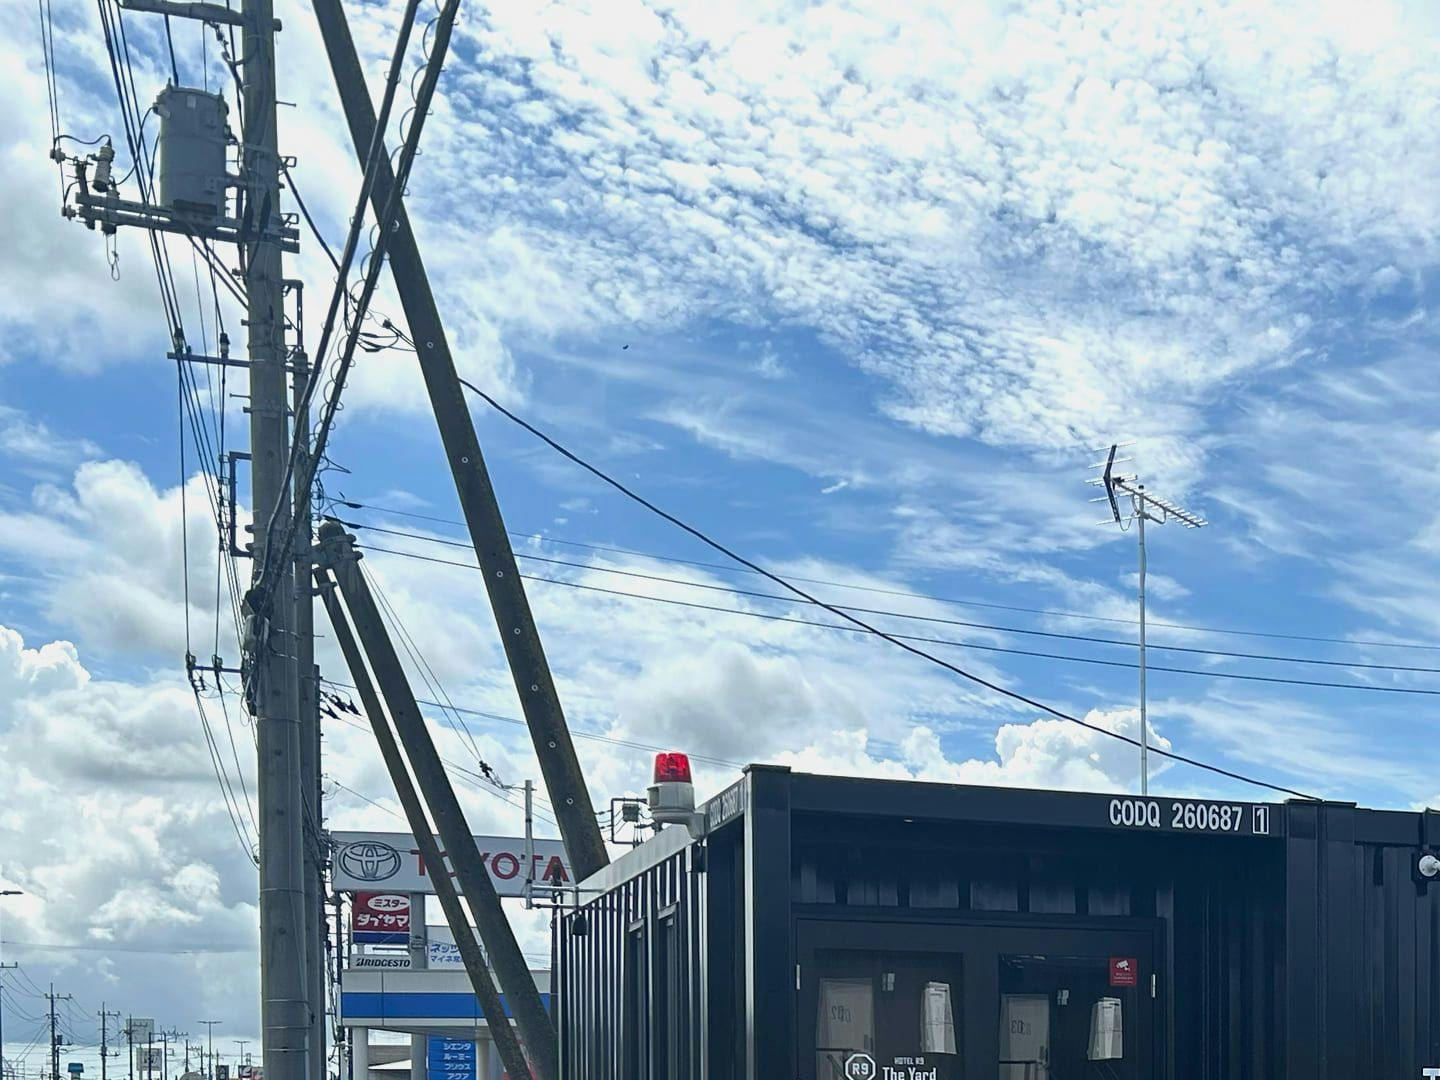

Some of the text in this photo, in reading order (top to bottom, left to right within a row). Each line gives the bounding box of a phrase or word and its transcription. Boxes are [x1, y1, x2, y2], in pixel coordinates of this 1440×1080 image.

[1109, 799, 1161, 828] CODQ
[1171, 803, 1243, 831] 260687
[374, 898, 408, 908] ミスター
[356, 958, 411, 968] BRIDGESTO
[852, 1062, 869, 1075] R9
